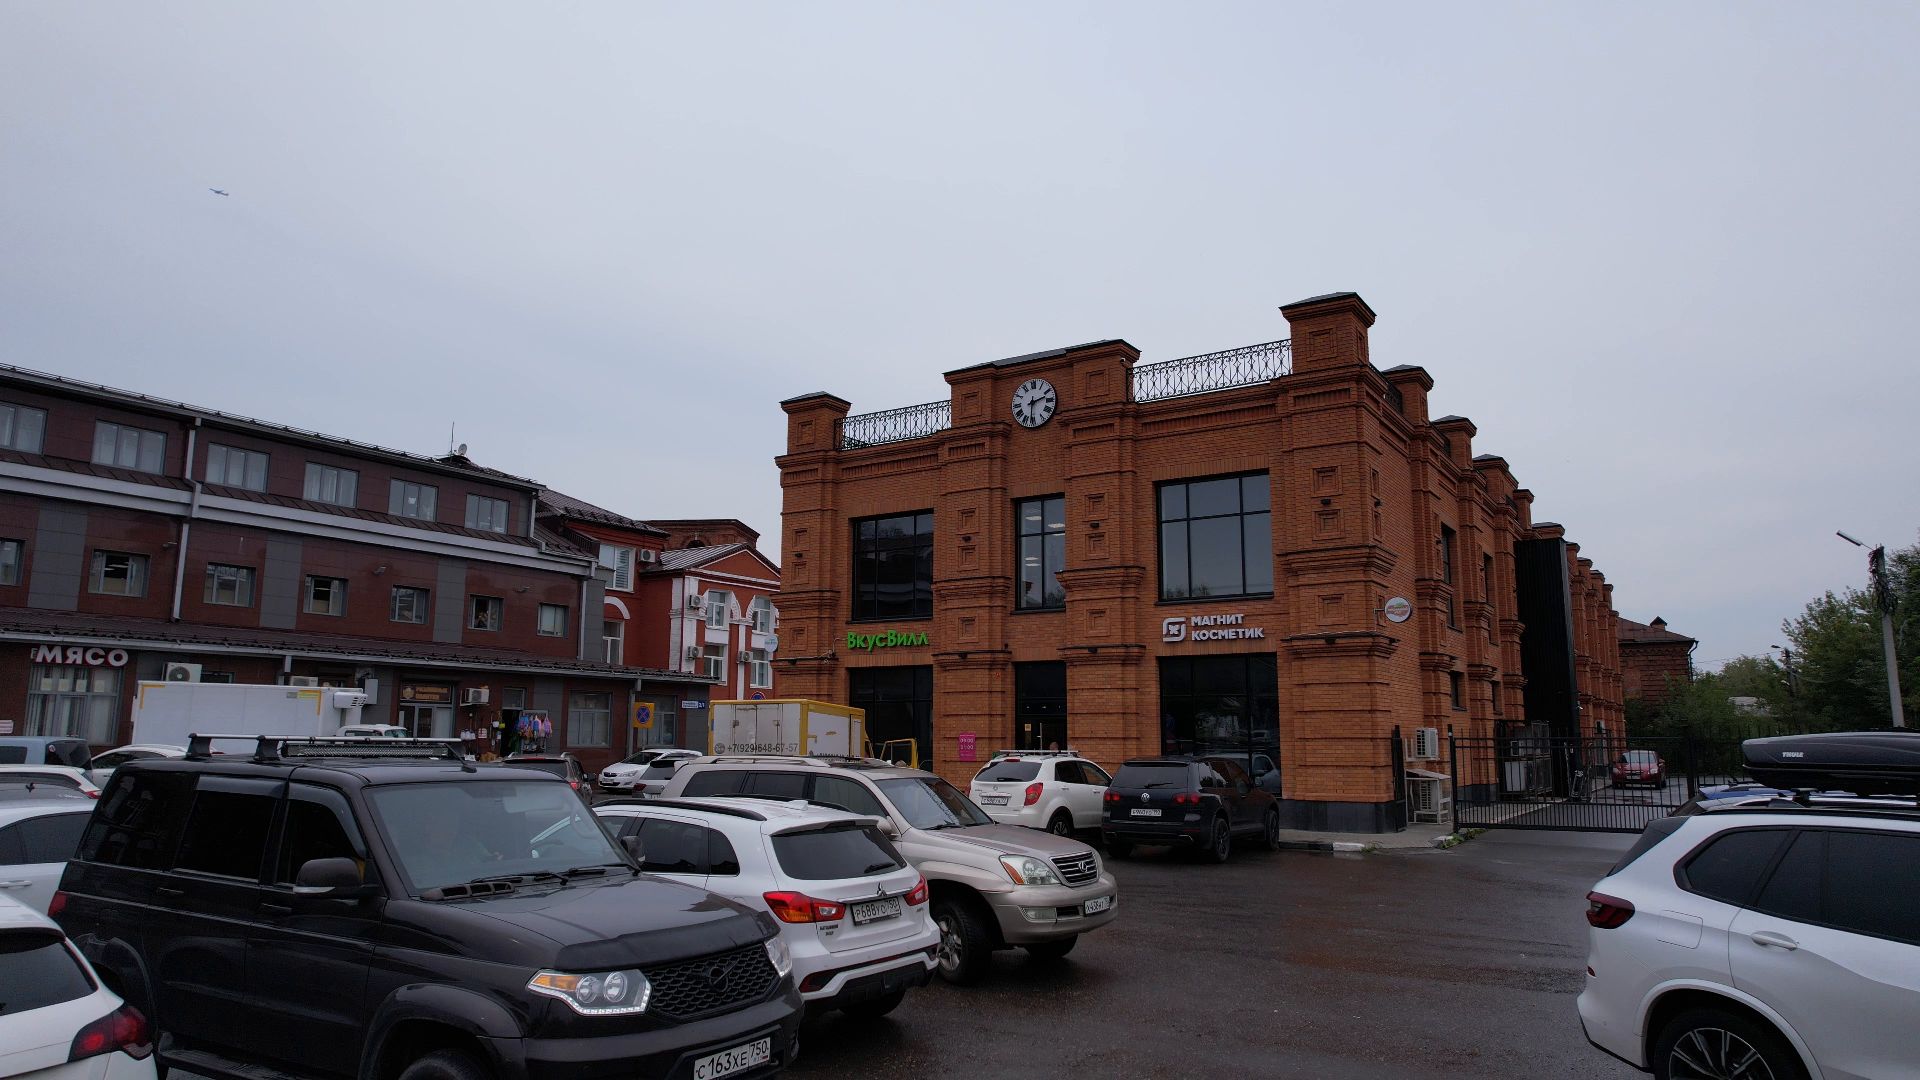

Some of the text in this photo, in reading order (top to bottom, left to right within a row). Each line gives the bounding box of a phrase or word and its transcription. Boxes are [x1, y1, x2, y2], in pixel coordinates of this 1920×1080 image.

[1190, 613, 1244, 626] МАГНИТ
[847, 629, 929, 653] ВкусВилл
[1191, 627, 1265, 641] КОСМЕТИК
